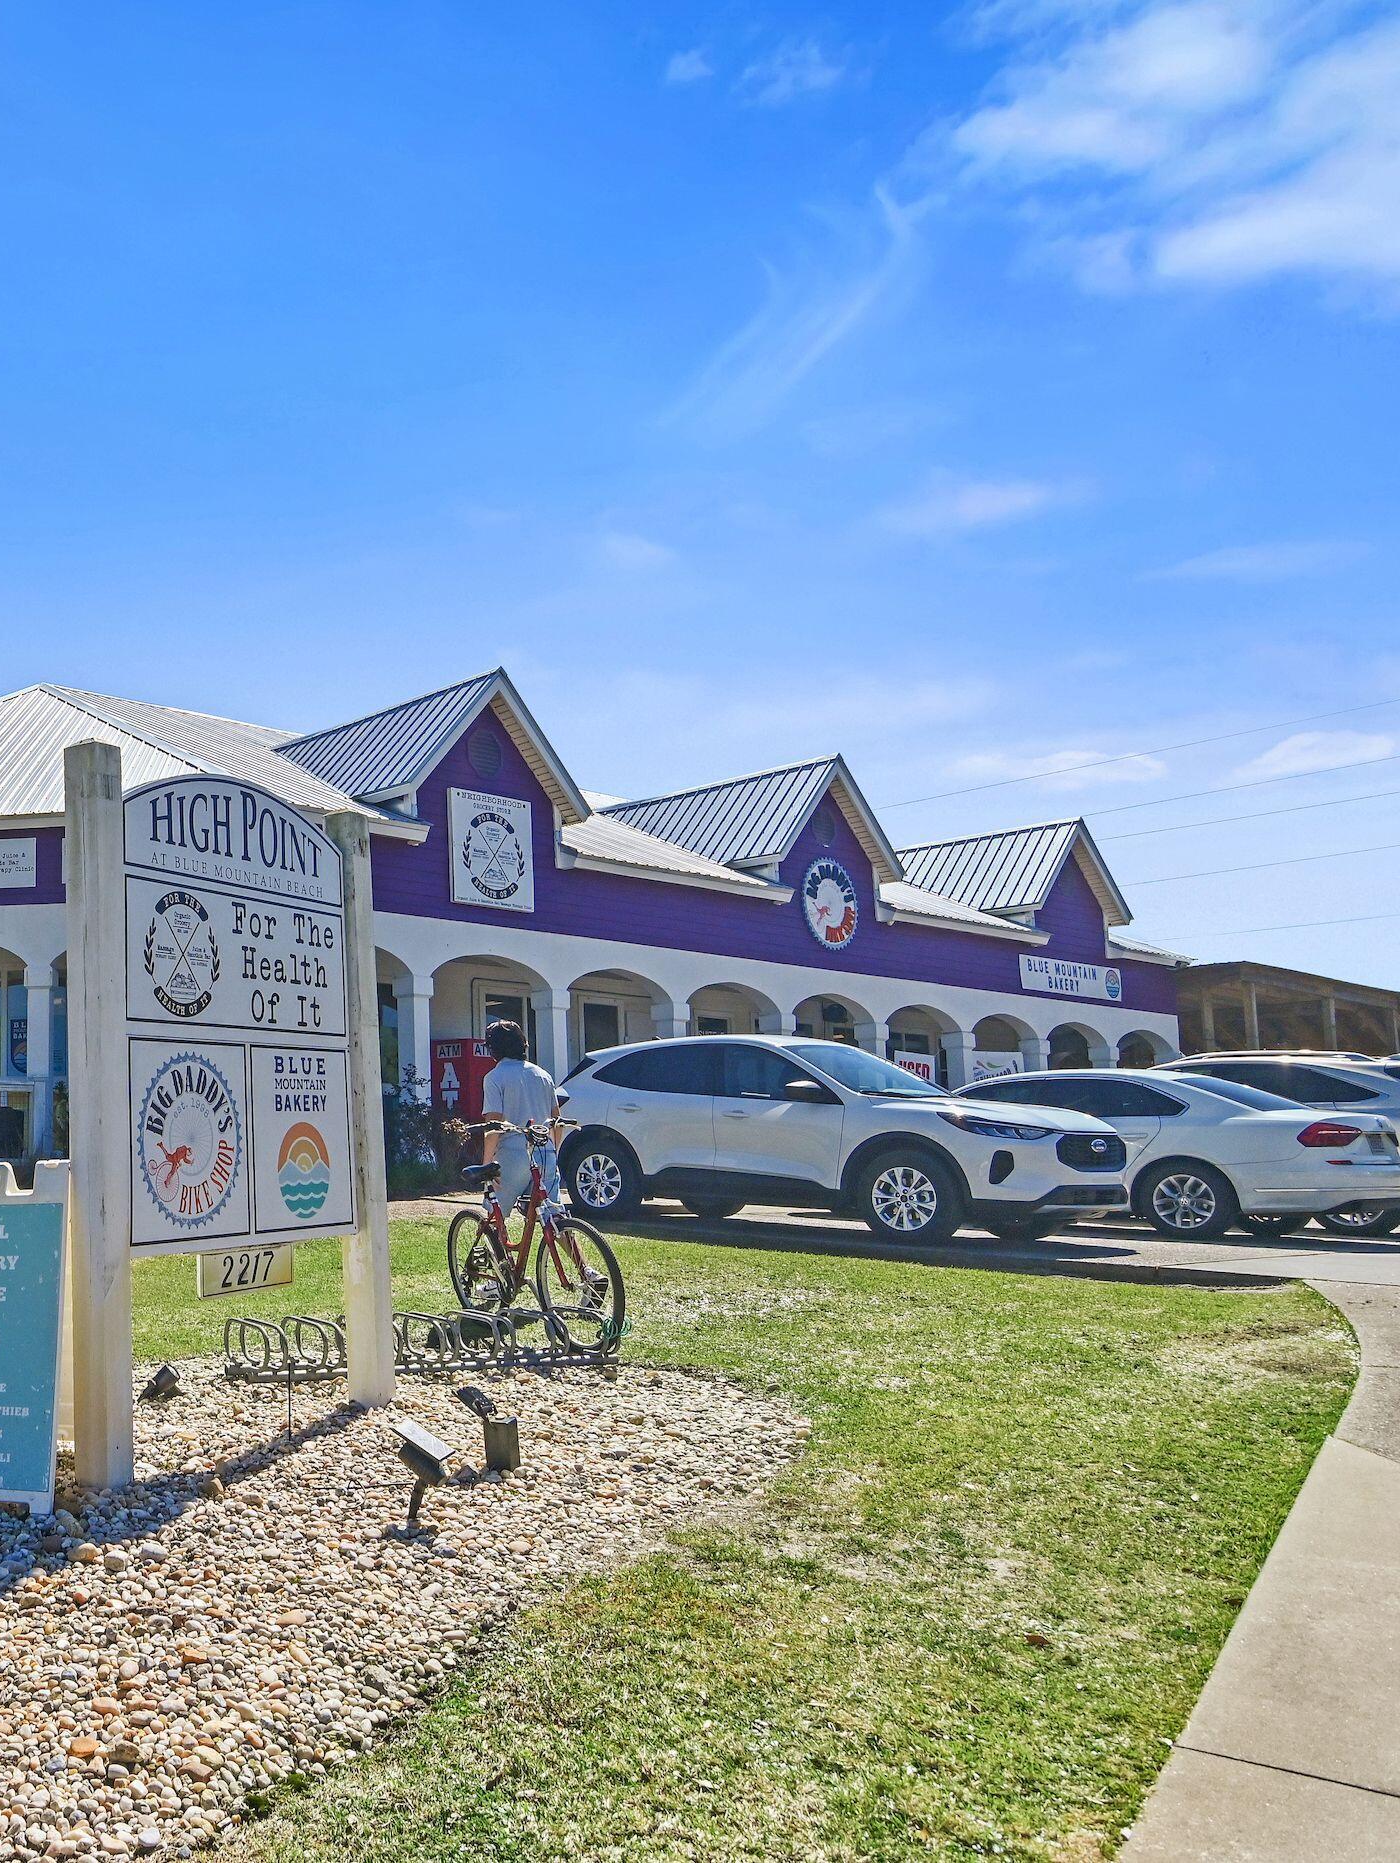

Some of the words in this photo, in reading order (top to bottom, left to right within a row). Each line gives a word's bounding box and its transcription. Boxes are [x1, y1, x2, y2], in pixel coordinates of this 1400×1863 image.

[461, 791, 522, 809] NEIGHBORHOOD
[477, 813, 491, 824] FOR
[149, 790, 233, 858] HIGH
[240, 790, 322, 878] POINT
[151, 851, 167, 866] AT
[175, 856, 207, 874] BLUE
[214, 864, 281, 890] MOUNTAIN
[287, 880, 323, 898] BEACH
[163, 893, 180, 907] FOR
[184, 894, 201, 913] THE
[232, 901, 276, 939] For
[293, 913, 333, 949] The
[242, 946, 327, 988] Health
[1027, 958, 1049, 974] BLUE
[1054, 963, 1097, 980] MOUNTAIN
[1048, 976, 1079, 992] BAKERY
[157, 990, 186, 1015] HEALTH
[189, 1003, 198, 1014] OF
[200, 993, 209, 1007] IT
[251, 990, 280, 1024] Of
[297, 995, 321, 1027] It
[438, 1045, 460, 1057] ATM
[274, 1055, 326, 1075] BLUE
[275, 1078, 326, 1090] MOUNTAIN
[146, 1086, 173, 1136] BIG
[170, 1065, 233, 1132] DADDY'S
[275, 1094, 326, 1112] BAKERY
[179, 1180, 213, 1214] BIKE
[210, 1139, 234, 1194] SHOP
[221, 1251, 274, 1288] 2217
